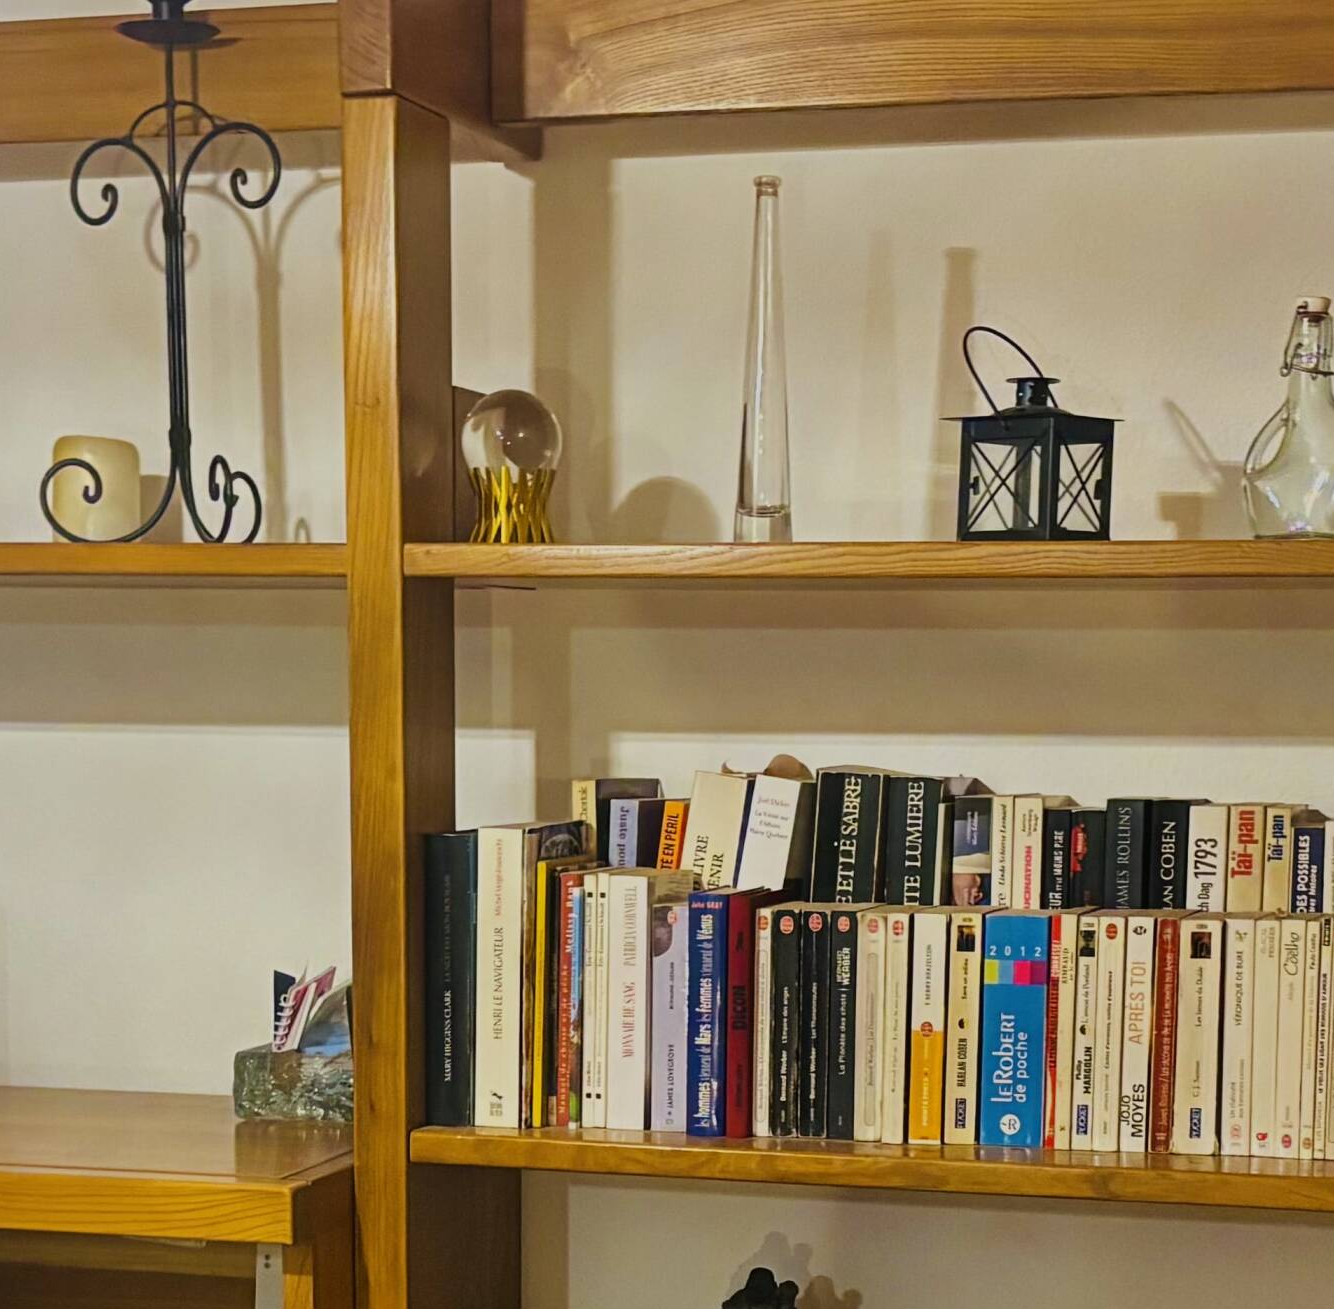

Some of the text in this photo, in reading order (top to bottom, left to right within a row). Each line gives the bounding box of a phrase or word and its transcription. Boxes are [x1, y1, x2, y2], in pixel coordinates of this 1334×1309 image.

[841, 778, 861, 835] SABRE
[905, 782, 924, 867] LUMIERE
[618, 844, 627, 866] pou
[660, 813, 679, 869] TÉ EN PÉRIL
[839, 840, 856, 864] LE
[1116, 807, 1132, 909] JAMES ROLLINS
[1160, 820, 1176, 910] LAN COBEN
[1194, 838, 1218, 899] Dag 1793
[1231, 810, 1258, 878] Taï-pan
[1267, 815, 1287, 862] Taï-pan
[707, 853, 724, 887] ENIR
[837, 865, 854, 891] ET
[565, 879, 575, 954] Melissa Bank
[622, 885, 638, 967] PATRICIA CORNWELL
[493, 927, 504, 1040] HENRI LE NAVIGATEUR
[842, 947, 851, 985] WERBER
[1283, 932, 1301, 976] Coelho
[622, 982, 636, 1058] MONNAIE DE SANG
[693, 914, 713, 1128] les hommes viennent de Mars les femmes viennent de Vénus
[1125, 960, 1146, 1045] APRÈS TOI
[443, 990, 452, 1082] MARY HIGGINS CLARK
[957, 1038, 968, 1087] HARLAN COBEN
[666, 1044, 675, 1109] JAMES LOVEGROVE
[838, 1064, 845, 1075] La
[1016, 1032, 1029, 1103] de poche
[1120, 1095, 1131, 1126] JOJO
[1131, 1083, 1144, 1138] MOYES
